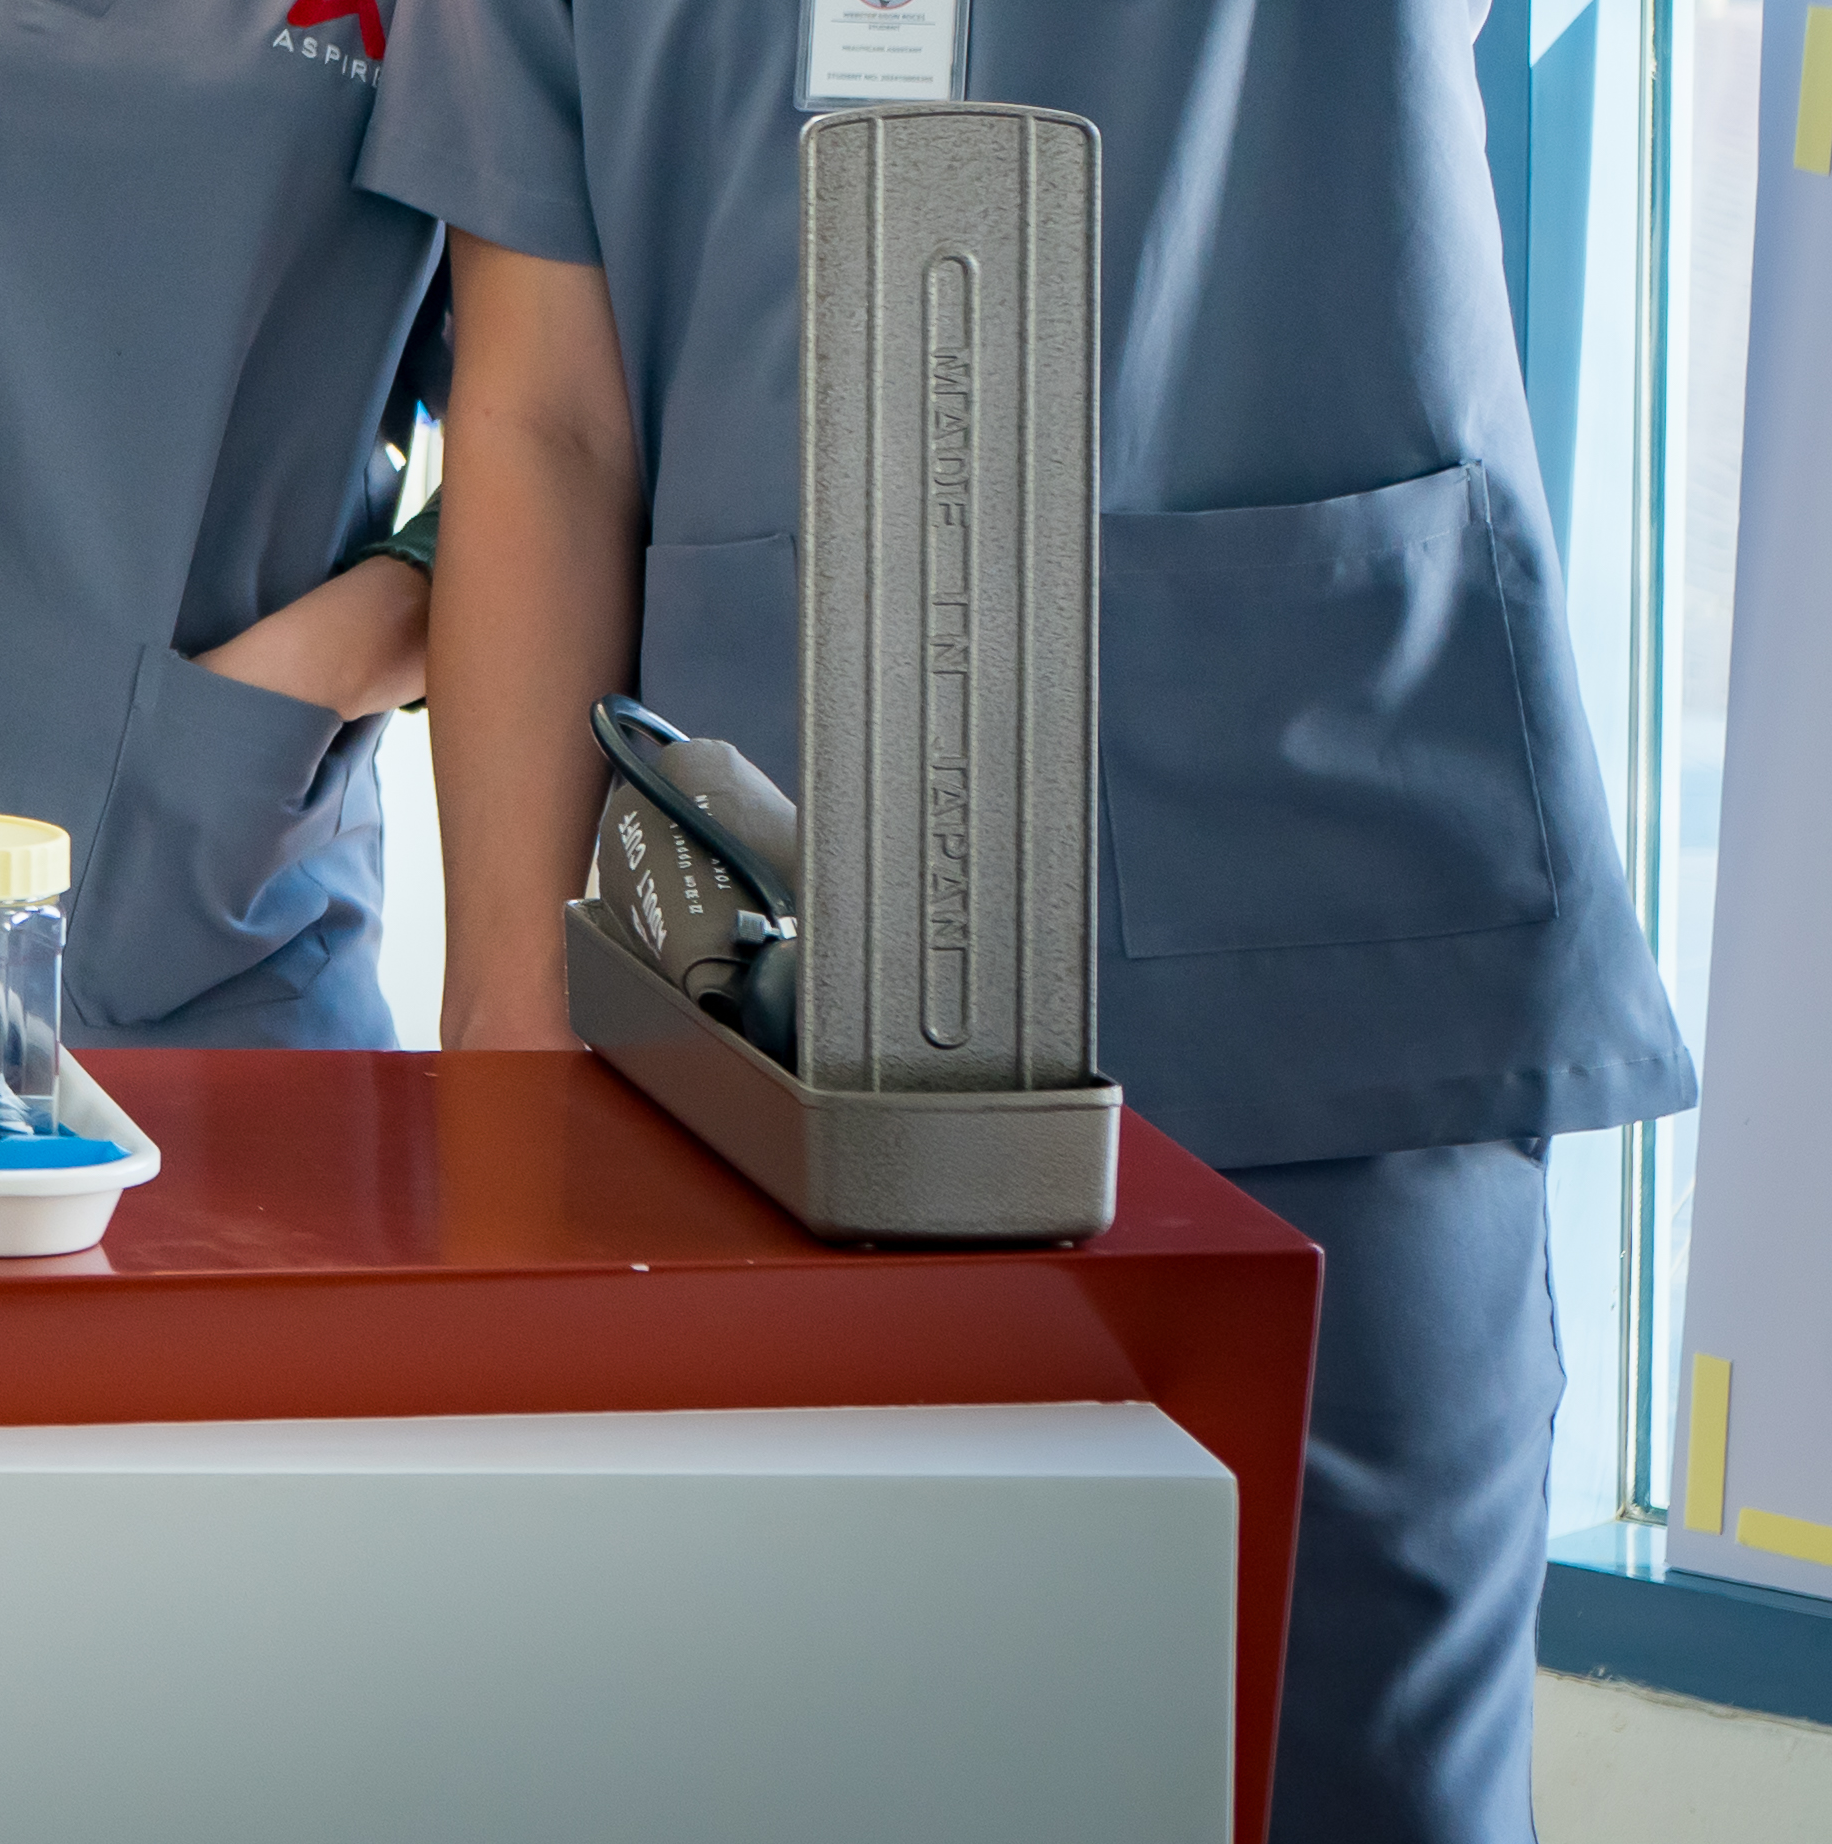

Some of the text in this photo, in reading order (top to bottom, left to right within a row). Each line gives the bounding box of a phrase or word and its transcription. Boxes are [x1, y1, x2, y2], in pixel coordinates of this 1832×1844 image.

[929, 346, 971, 956] MADE IN JAPAN
[619, 811, 646, 871] CUFF
